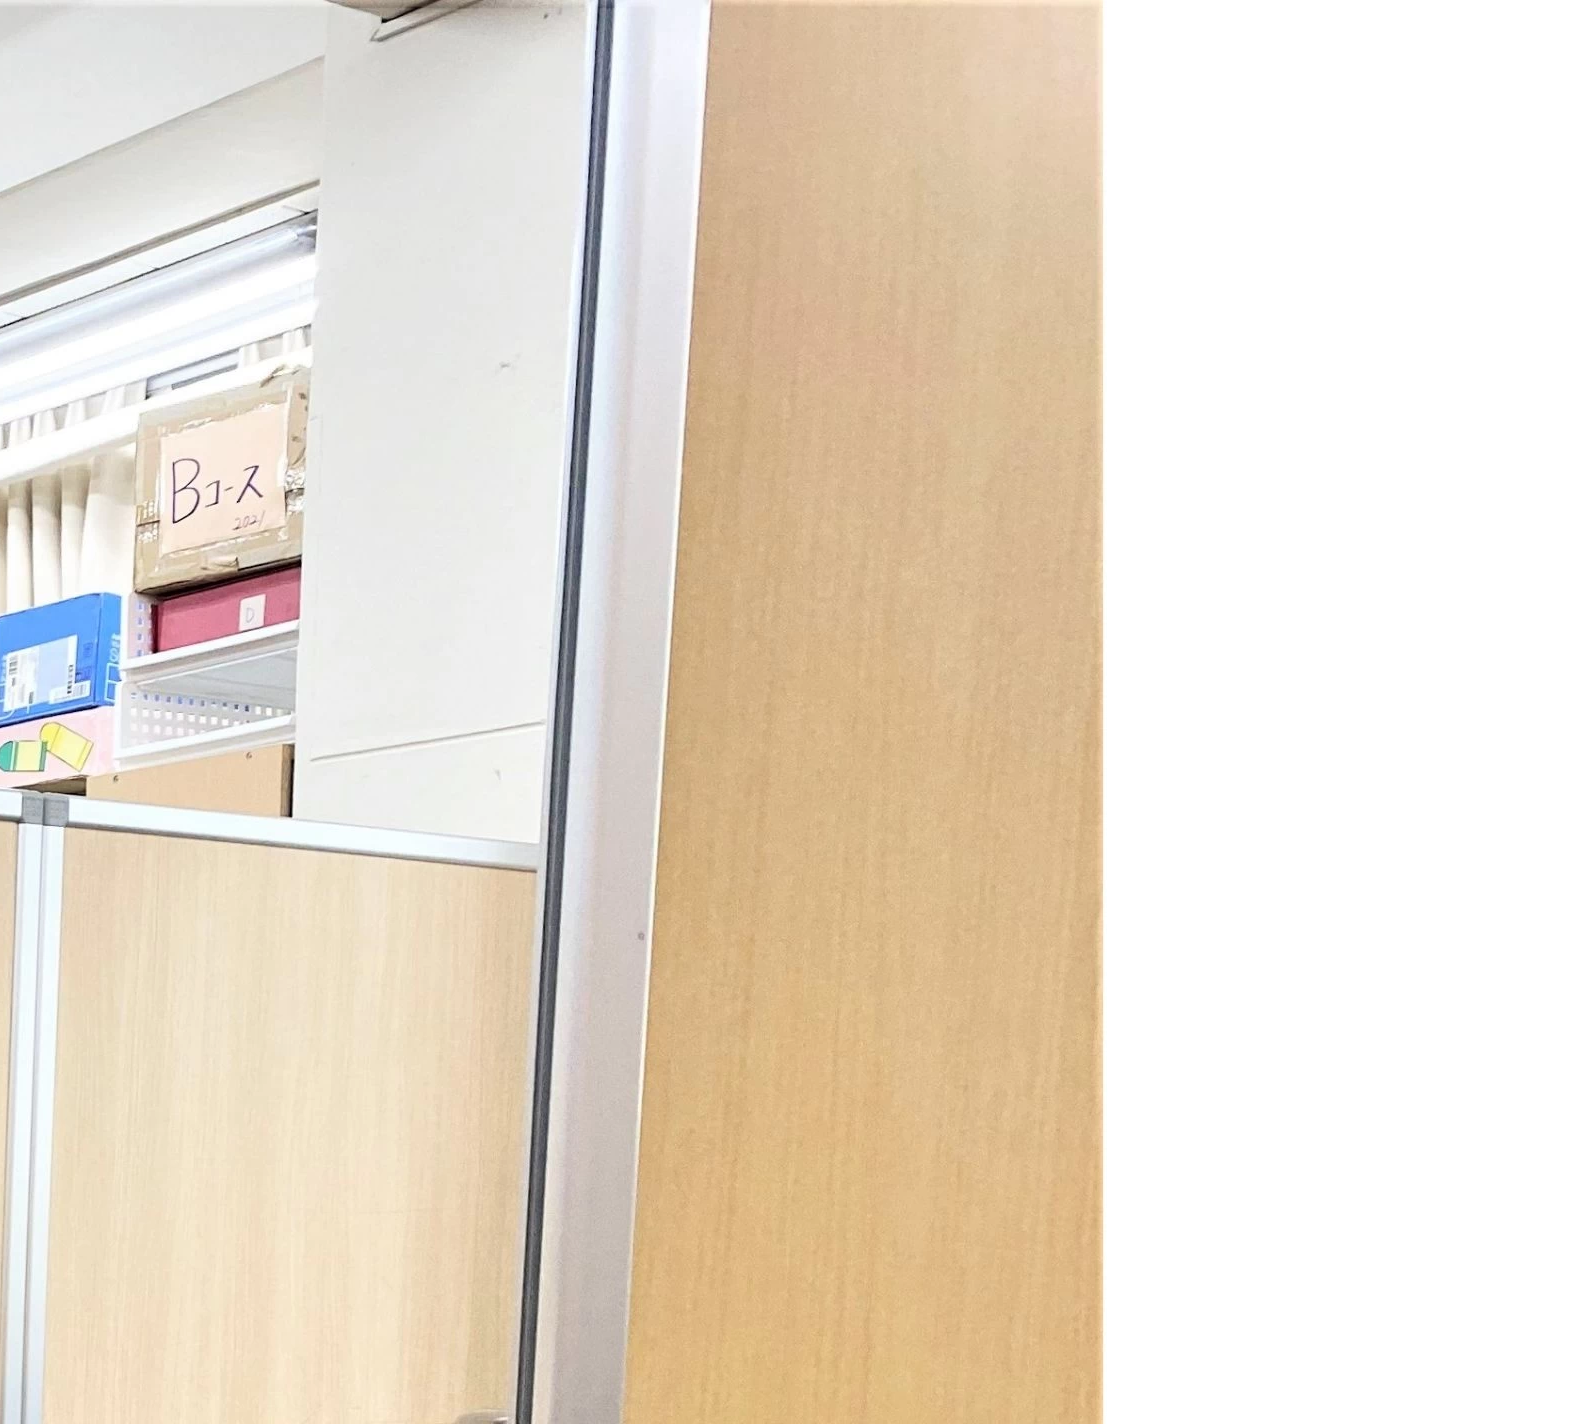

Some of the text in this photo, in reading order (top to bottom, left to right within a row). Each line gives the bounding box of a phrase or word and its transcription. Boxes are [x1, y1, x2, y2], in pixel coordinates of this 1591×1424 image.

[172, 458, 264, 524] Bコース
[232, 510, 266, 531] 2021
